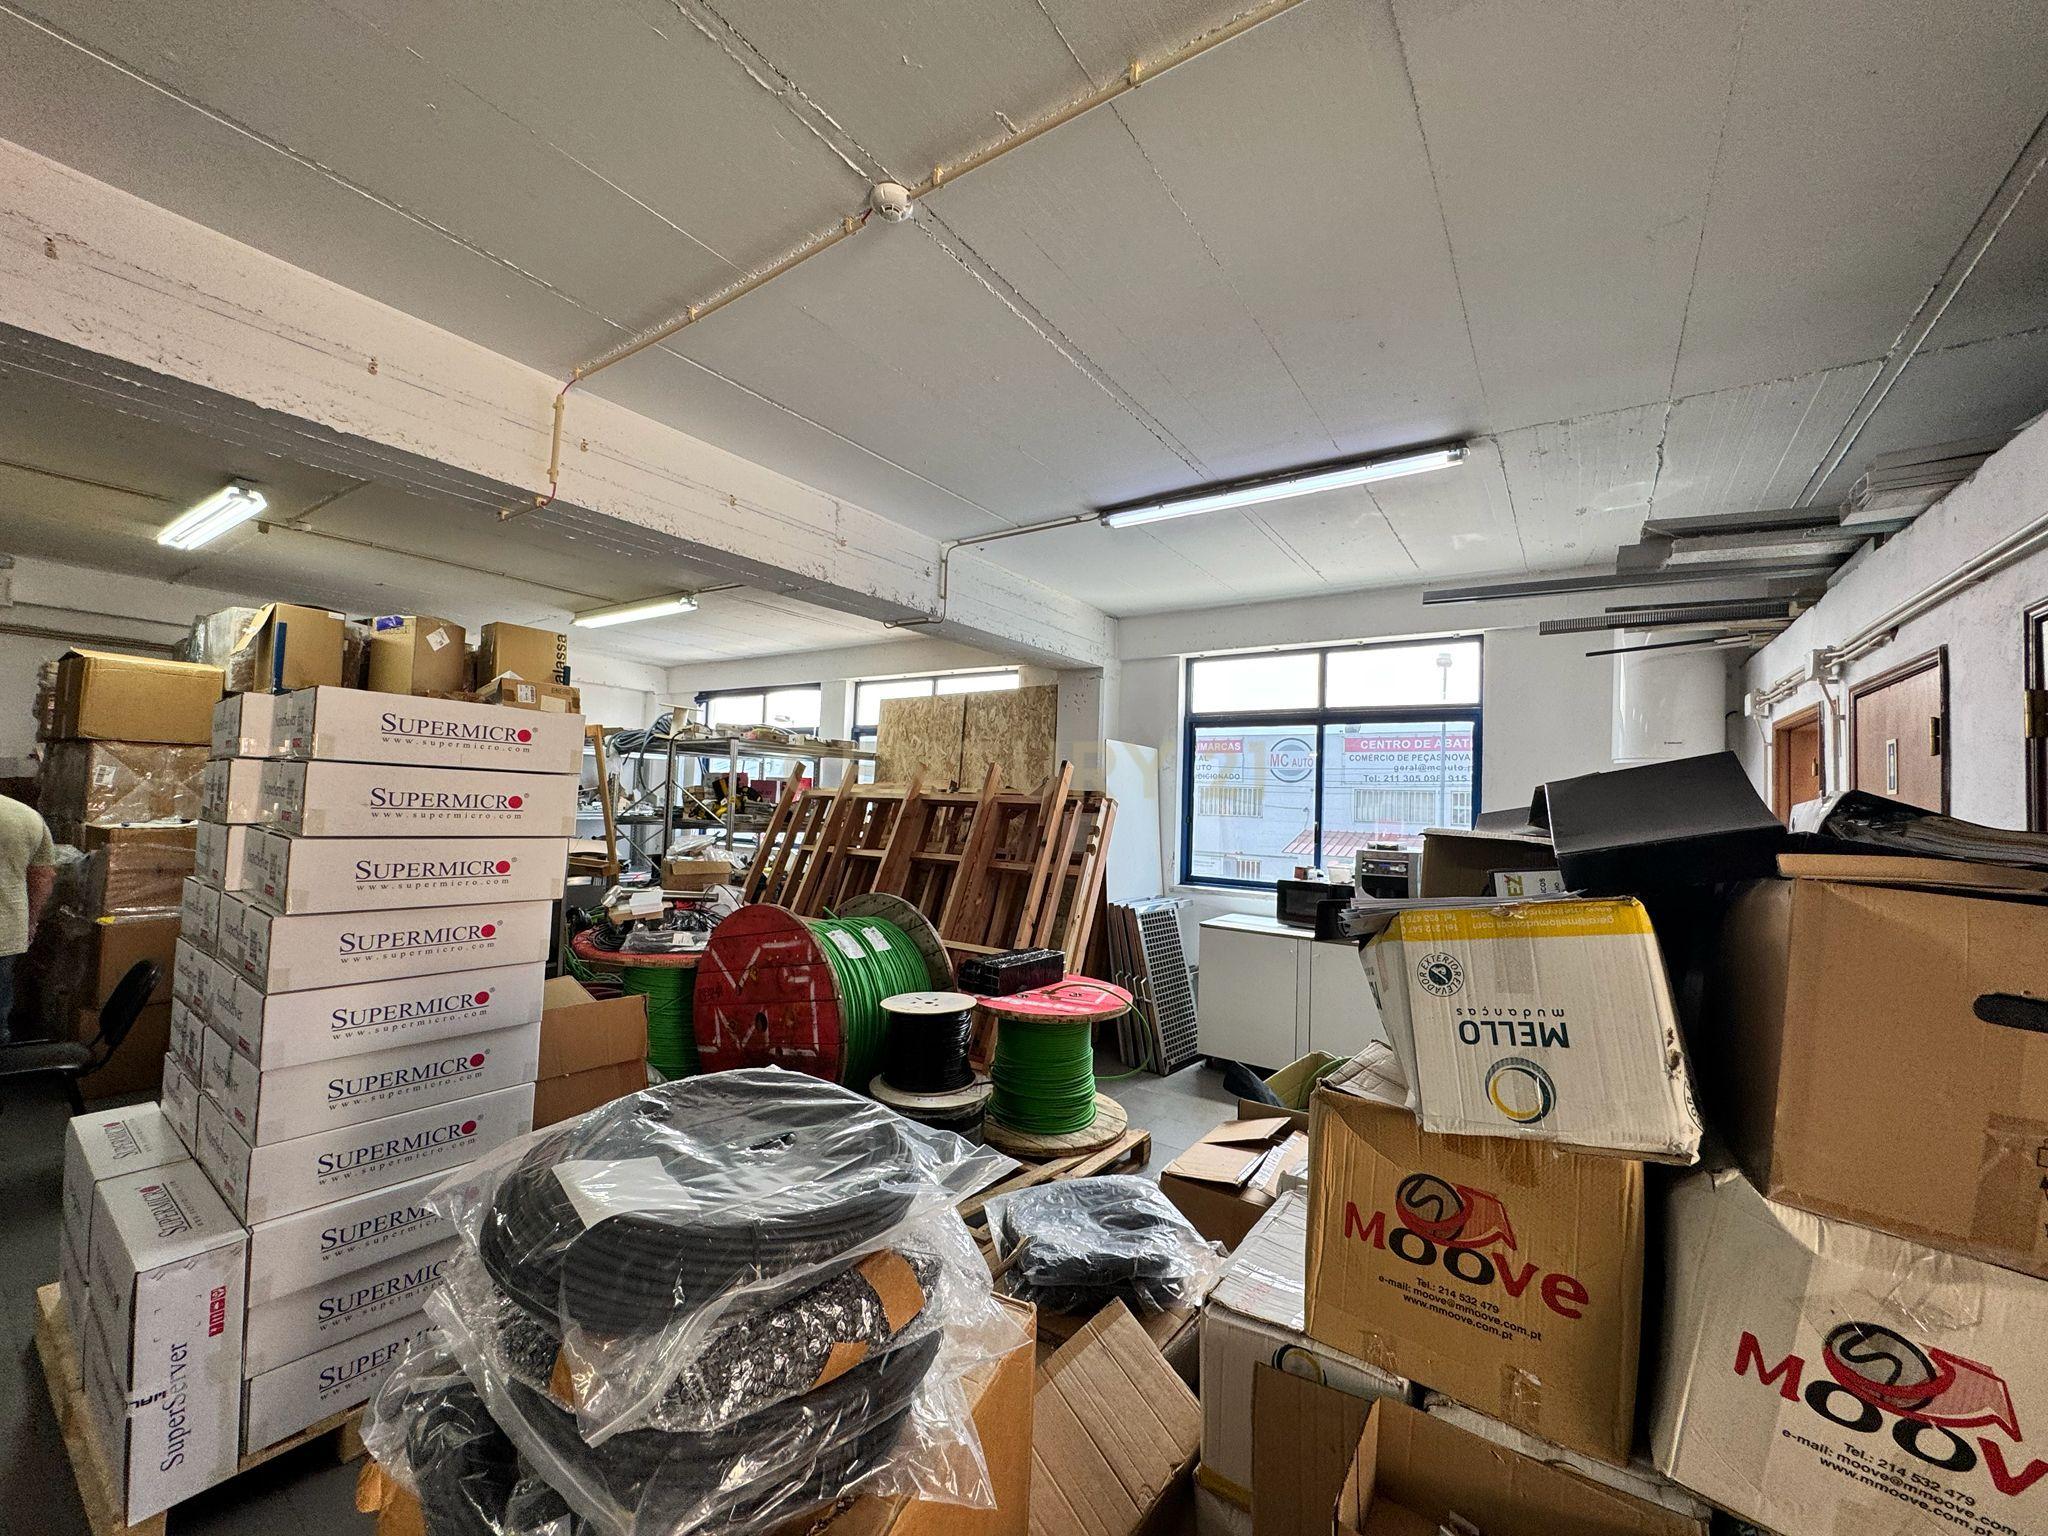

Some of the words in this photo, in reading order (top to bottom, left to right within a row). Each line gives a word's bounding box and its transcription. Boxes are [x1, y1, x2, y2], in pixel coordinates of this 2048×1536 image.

[1360, 739, 1411, 750] CENTRO
[1414, 739, 1431, 749] DE
[1397, 753, 1410, 761] DE
[1269, 753, 1289, 767] MC
[1291, 758, 1314, 768] AUTO
[1456, 1006, 1565, 1019] mudanças
[1459, 1020, 1570, 1048] MELLO
[1378, 1274, 1412, 1294] e-mail:
[1413, 1287, 1542, 1342] moove@mmoove.com.pt
[1416, 1277, 1436, 1292] Tel.:
[1438, 1285, 1456, 1299] 214
[1458, 1293, 1477, 1307] 532
[1480, 1301, 1499, 1314] 479
[1403, 1293, 1513, 1341] www.mmoove.com.pt
[1782, 1428, 1834, 1457] e-mail:
[1843, 1442, 1873, 1464] Tel.:
[1878, 1459, 1907, 1478] 214
[1911, 1474, 1942, 1492] 532
[1944, 1489, 1976, 1507] 479
